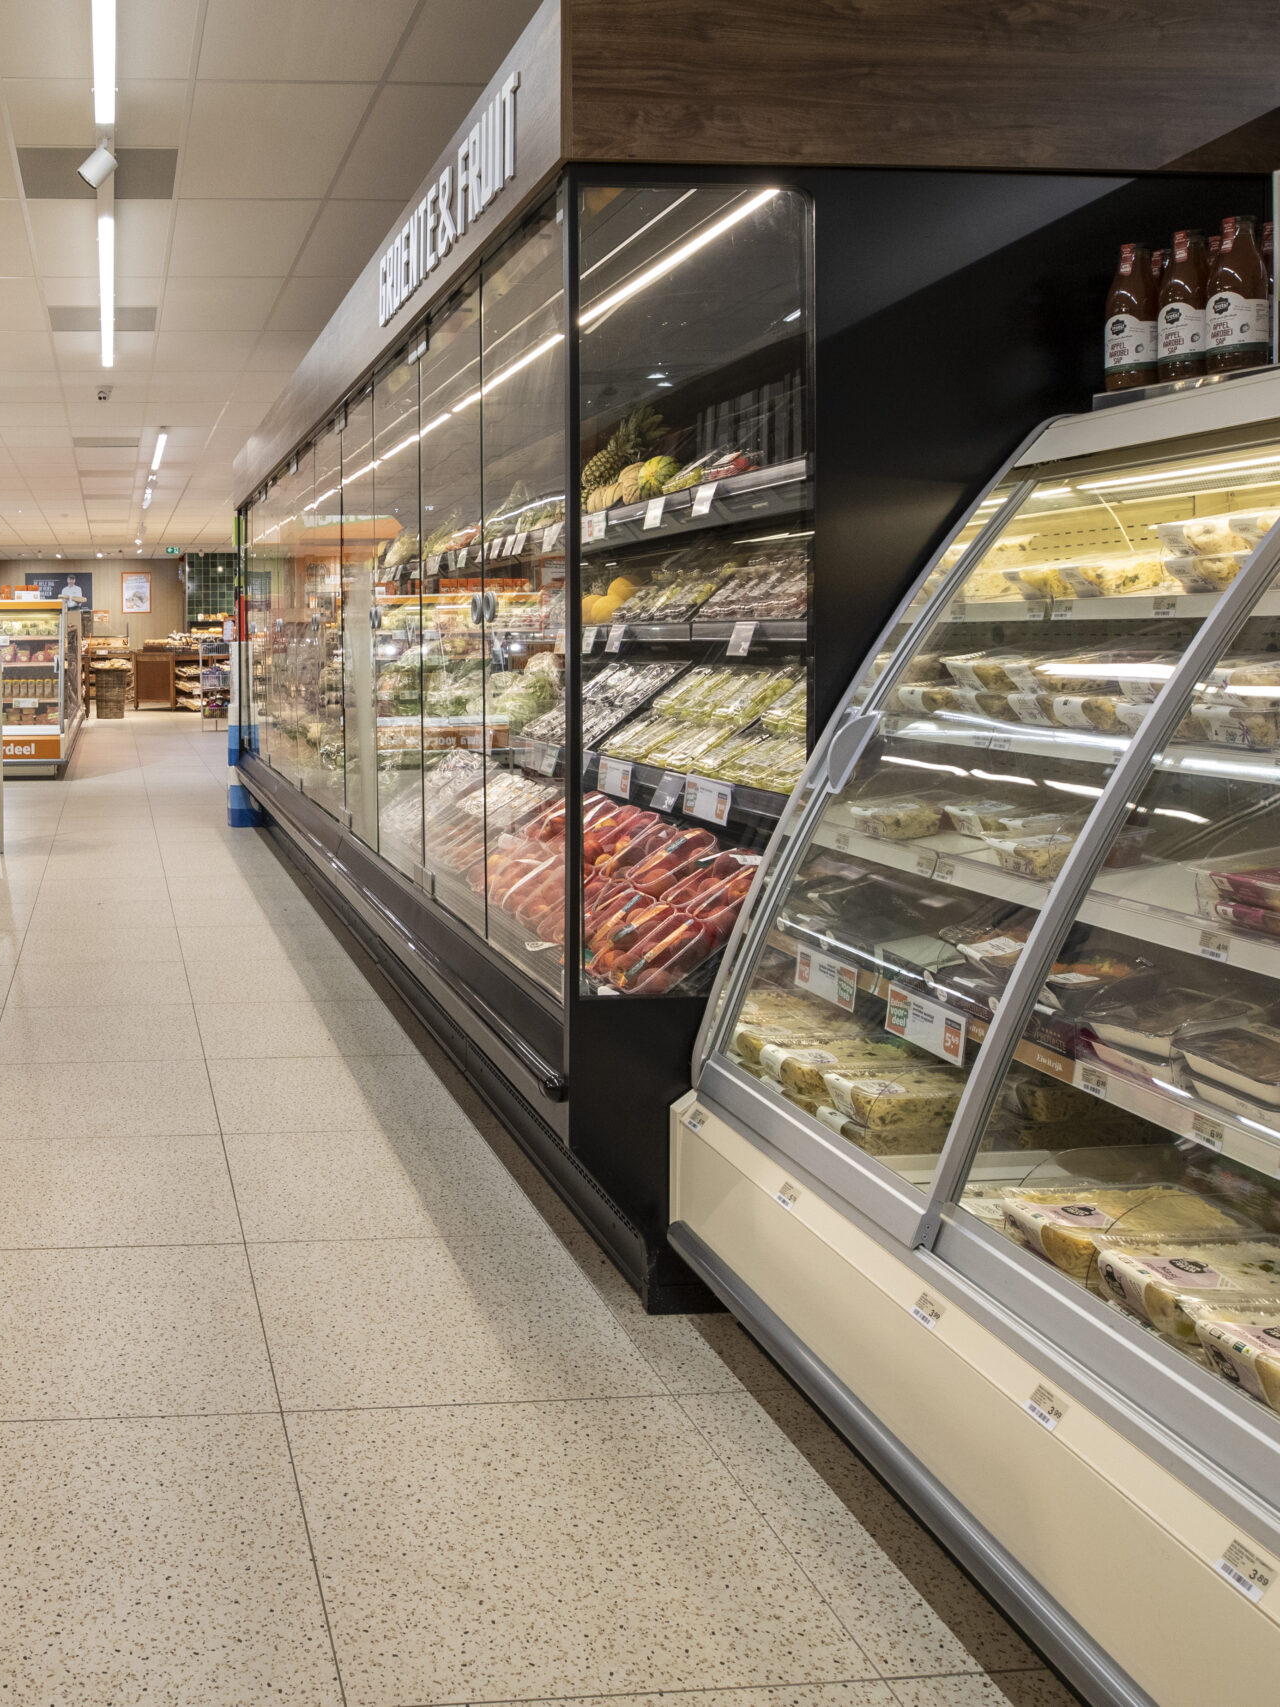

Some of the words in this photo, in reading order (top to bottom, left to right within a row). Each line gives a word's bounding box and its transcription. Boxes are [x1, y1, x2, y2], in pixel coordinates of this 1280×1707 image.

[379, 183, 439, 328] GROENTE
[438, 166, 457, 259] &
[456, 71, 521, 237] FRUIT
